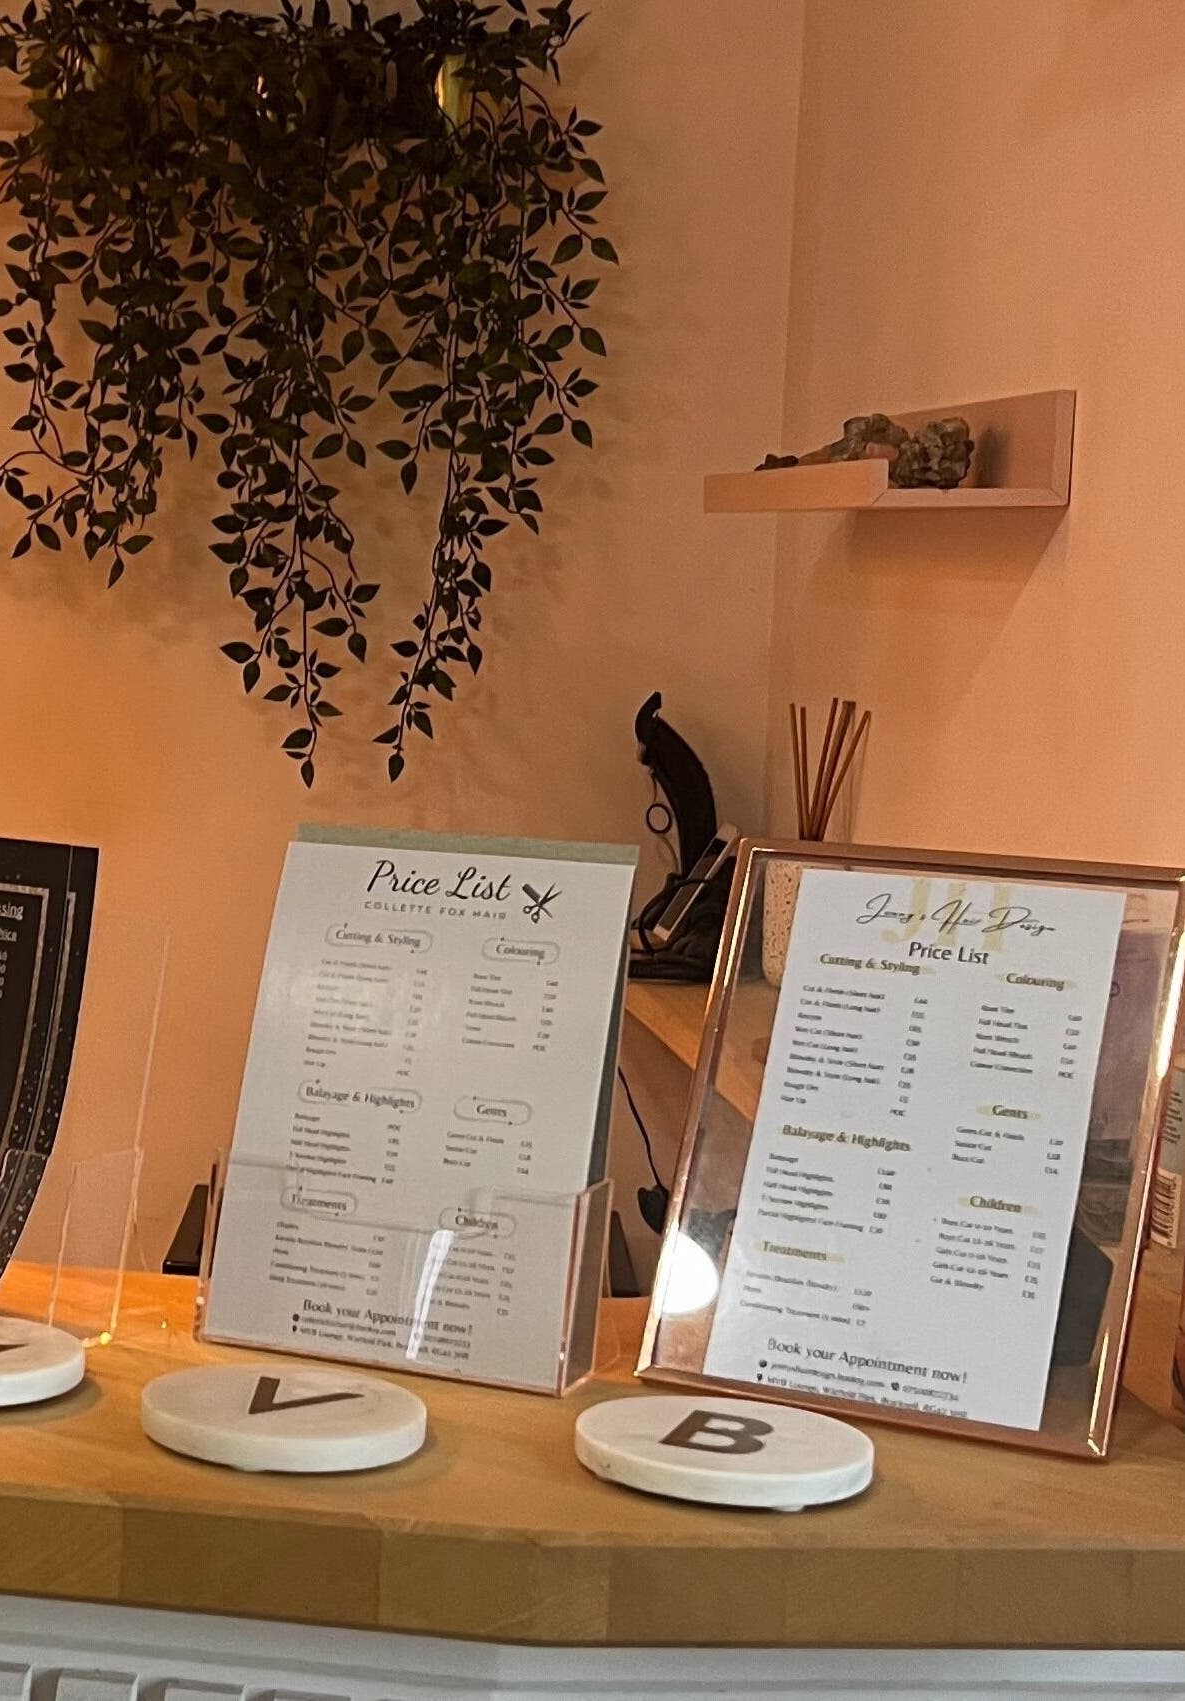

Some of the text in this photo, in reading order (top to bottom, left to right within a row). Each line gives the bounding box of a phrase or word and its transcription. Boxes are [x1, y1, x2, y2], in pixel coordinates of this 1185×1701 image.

[367, 860, 512, 900] Price List
[364, 901, 431, 914] COLLETTE
[439, 907, 465, 916] FOX
[335, 929, 421, 948] Cutting & Styling
[496, 944, 545, 959] Colouring
[909, 941, 989, 965] Price List
[820, 953, 920, 975] Cutting & Styling
[1006, 973, 1064, 991] Colouring
[352, 1092, 360, 1102] &
[992, 1104, 1028, 1119] Gents
[783, 1124, 912, 1151] Balayage & Highlights
[970, 1196, 1022, 1213] Children
[764, 1241, 826, 1261] Treatments
[304, 1299, 332, 1314] Book
[336, 1307, 361, 1318] your
[365, 1309, 439, 1330] Appointnt
[768, 1338, 801, 1354] Book
[806, 1348, 834, 1361] your
[839, 1351, 927, 1377] Appointment
[932, 1370, 967, 1383] now!
[248, 1376, 364, 1415] V
[660, 1409, 775, 1455] B
